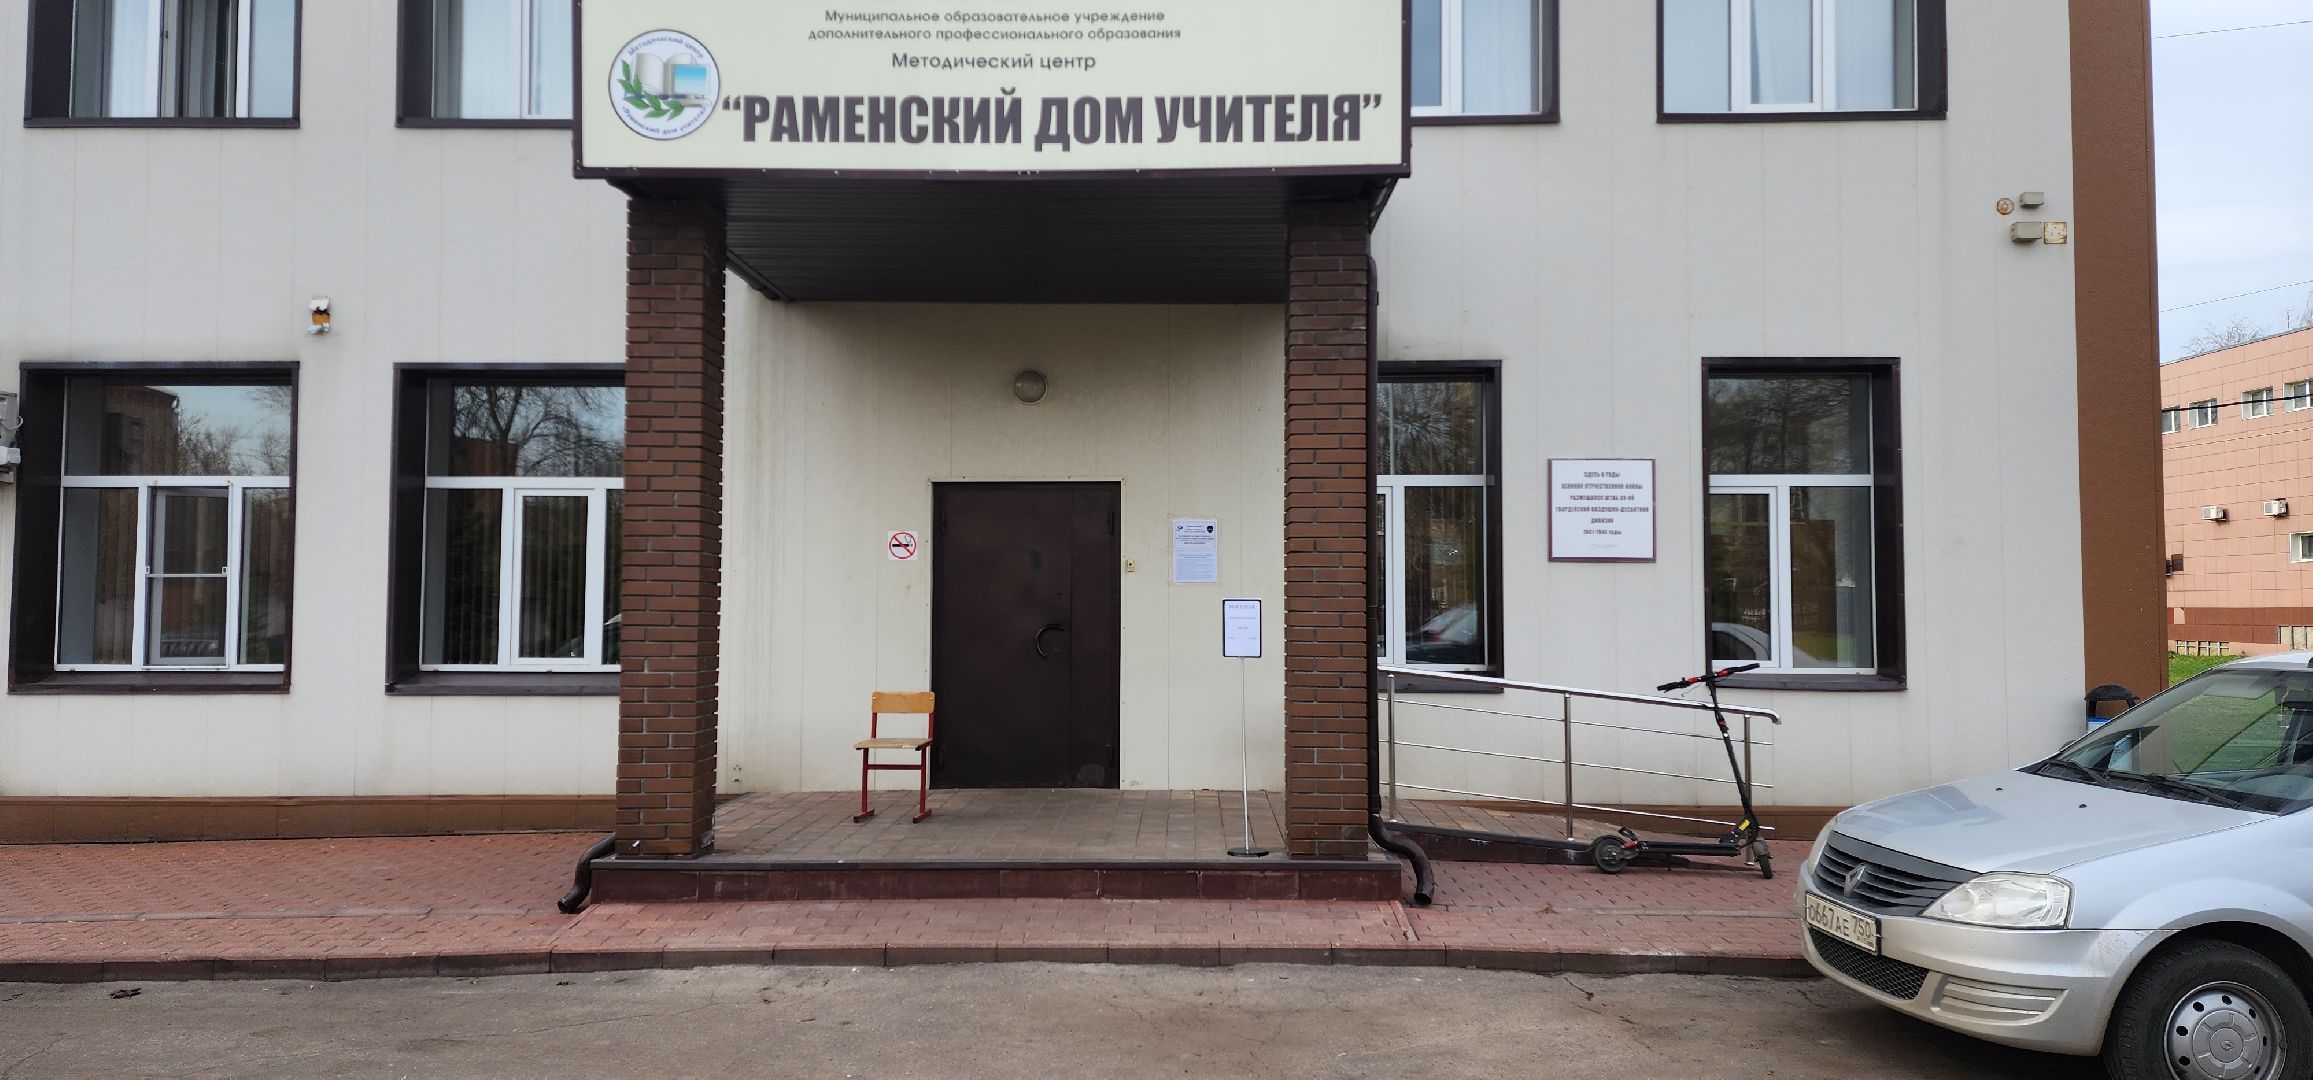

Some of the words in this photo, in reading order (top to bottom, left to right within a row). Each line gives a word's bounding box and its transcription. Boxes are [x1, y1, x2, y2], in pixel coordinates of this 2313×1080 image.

[824, 10, 940, 24] Муниципальное
[943, 10, 1070, 25] образовательное
[1073, 11, 1166, 25] учреждение
[807, 29, 932, 41] дополнительного
[935, 28, 1084, 42] профессионального
[1087, 27, 1182, 42] образования
[891, 52, 1034, 71] Методический
[1039, 56, 1097, 73] центр
[721, 87, 1022, 145] “РАМЕНСКИЙ
[1034, 95, 1143, 153] ДОМ
[1154, 93, 1382, 144] УЧИТЕЛЯ”
